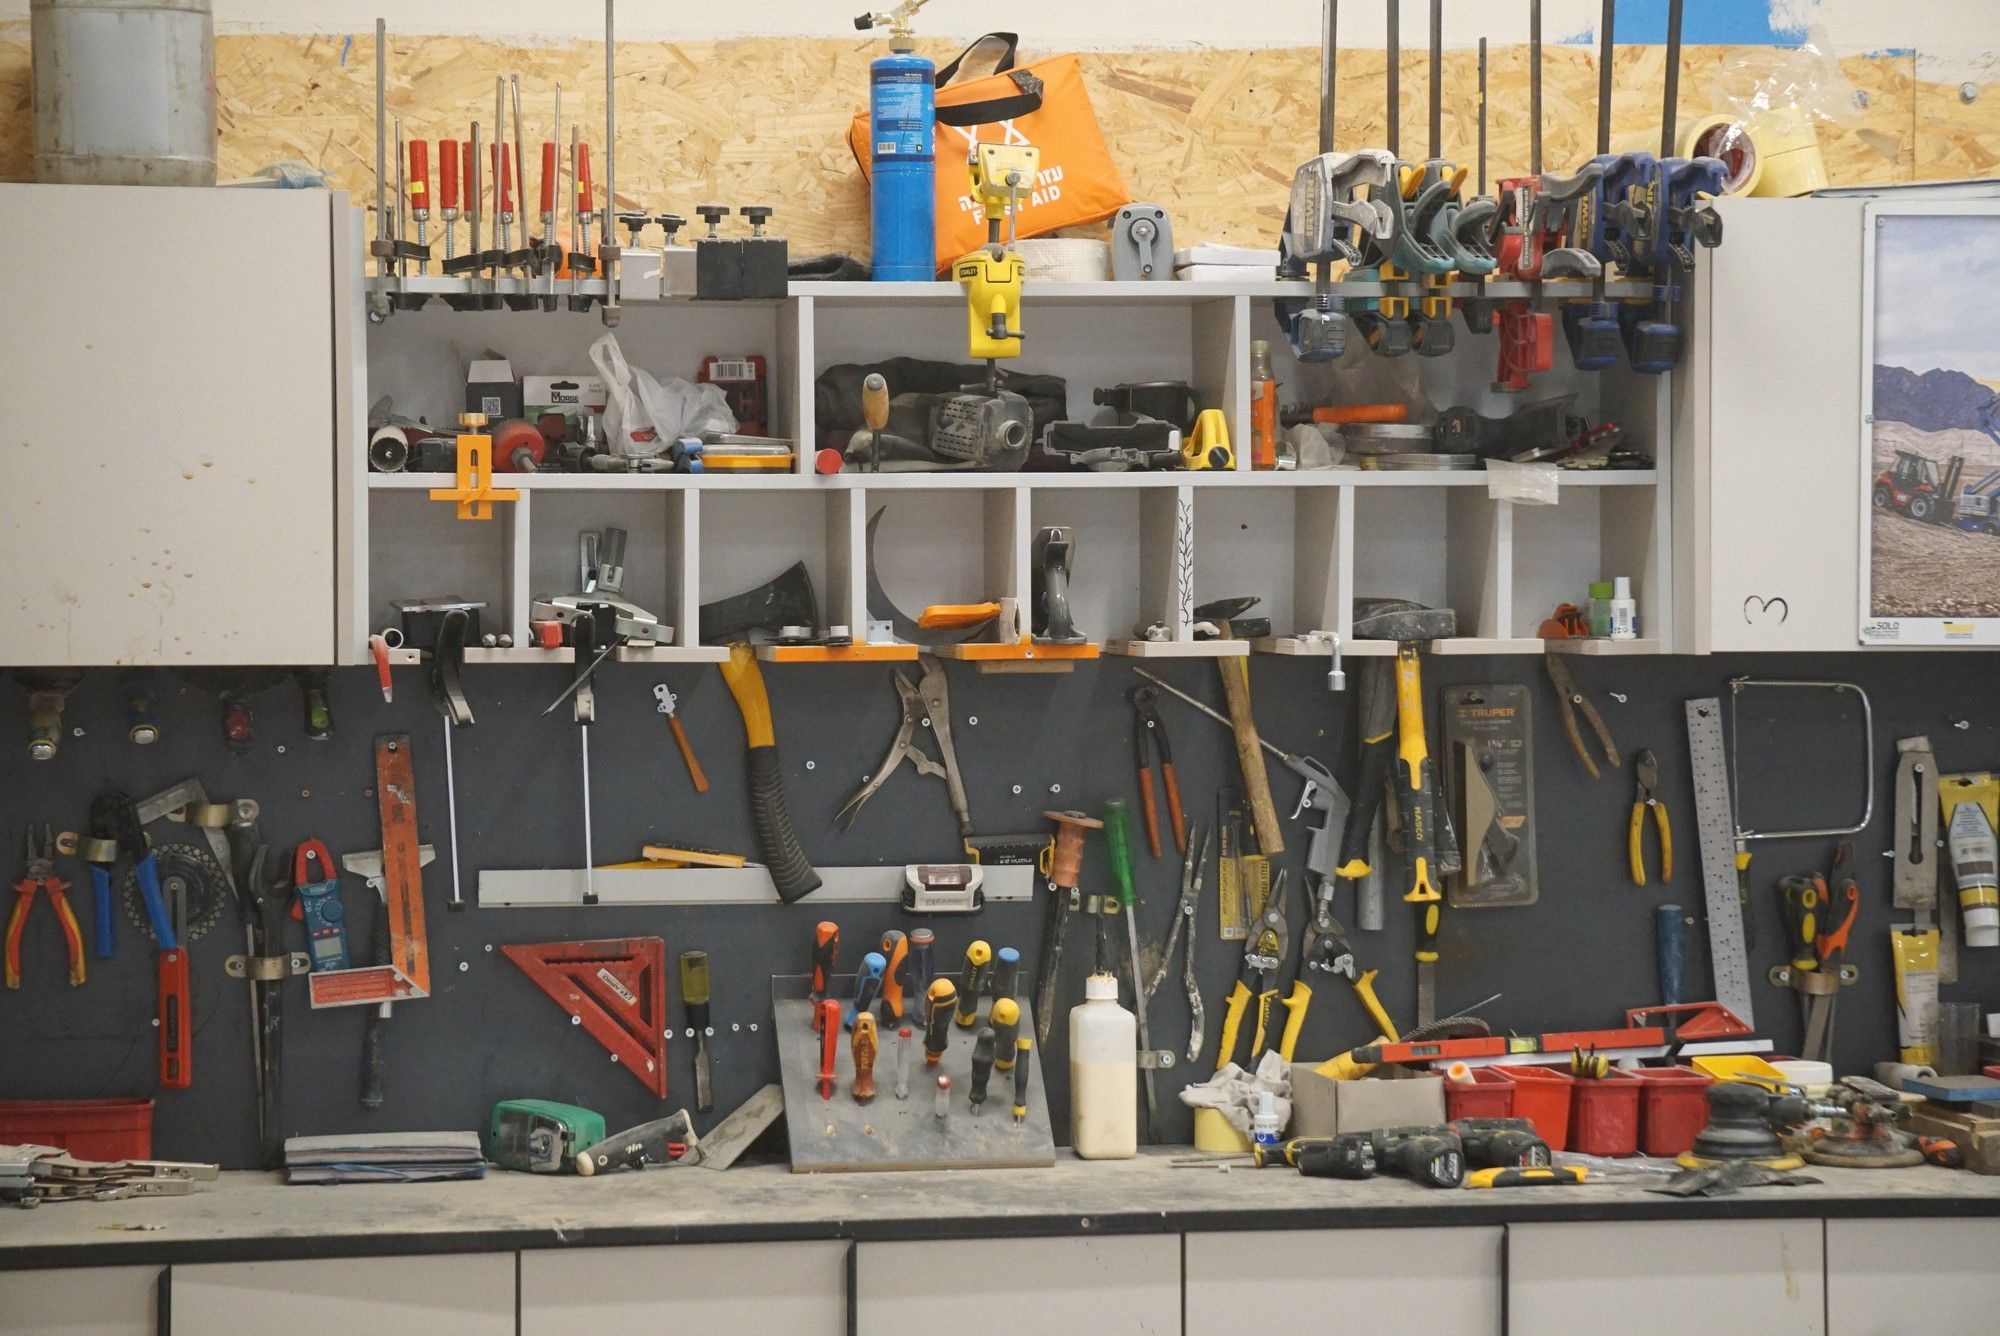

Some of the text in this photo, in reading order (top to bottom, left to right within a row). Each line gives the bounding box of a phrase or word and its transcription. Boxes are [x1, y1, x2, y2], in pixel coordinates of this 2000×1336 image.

[1031, 185, 1061, 207] AID
[1305, 179, 1315, 237] IRWIN
[960, 267, 977, 277] STANLEY
[551, 391, 579, 403] MORSE
[1472, 708, 1515, 717] TRUPER
